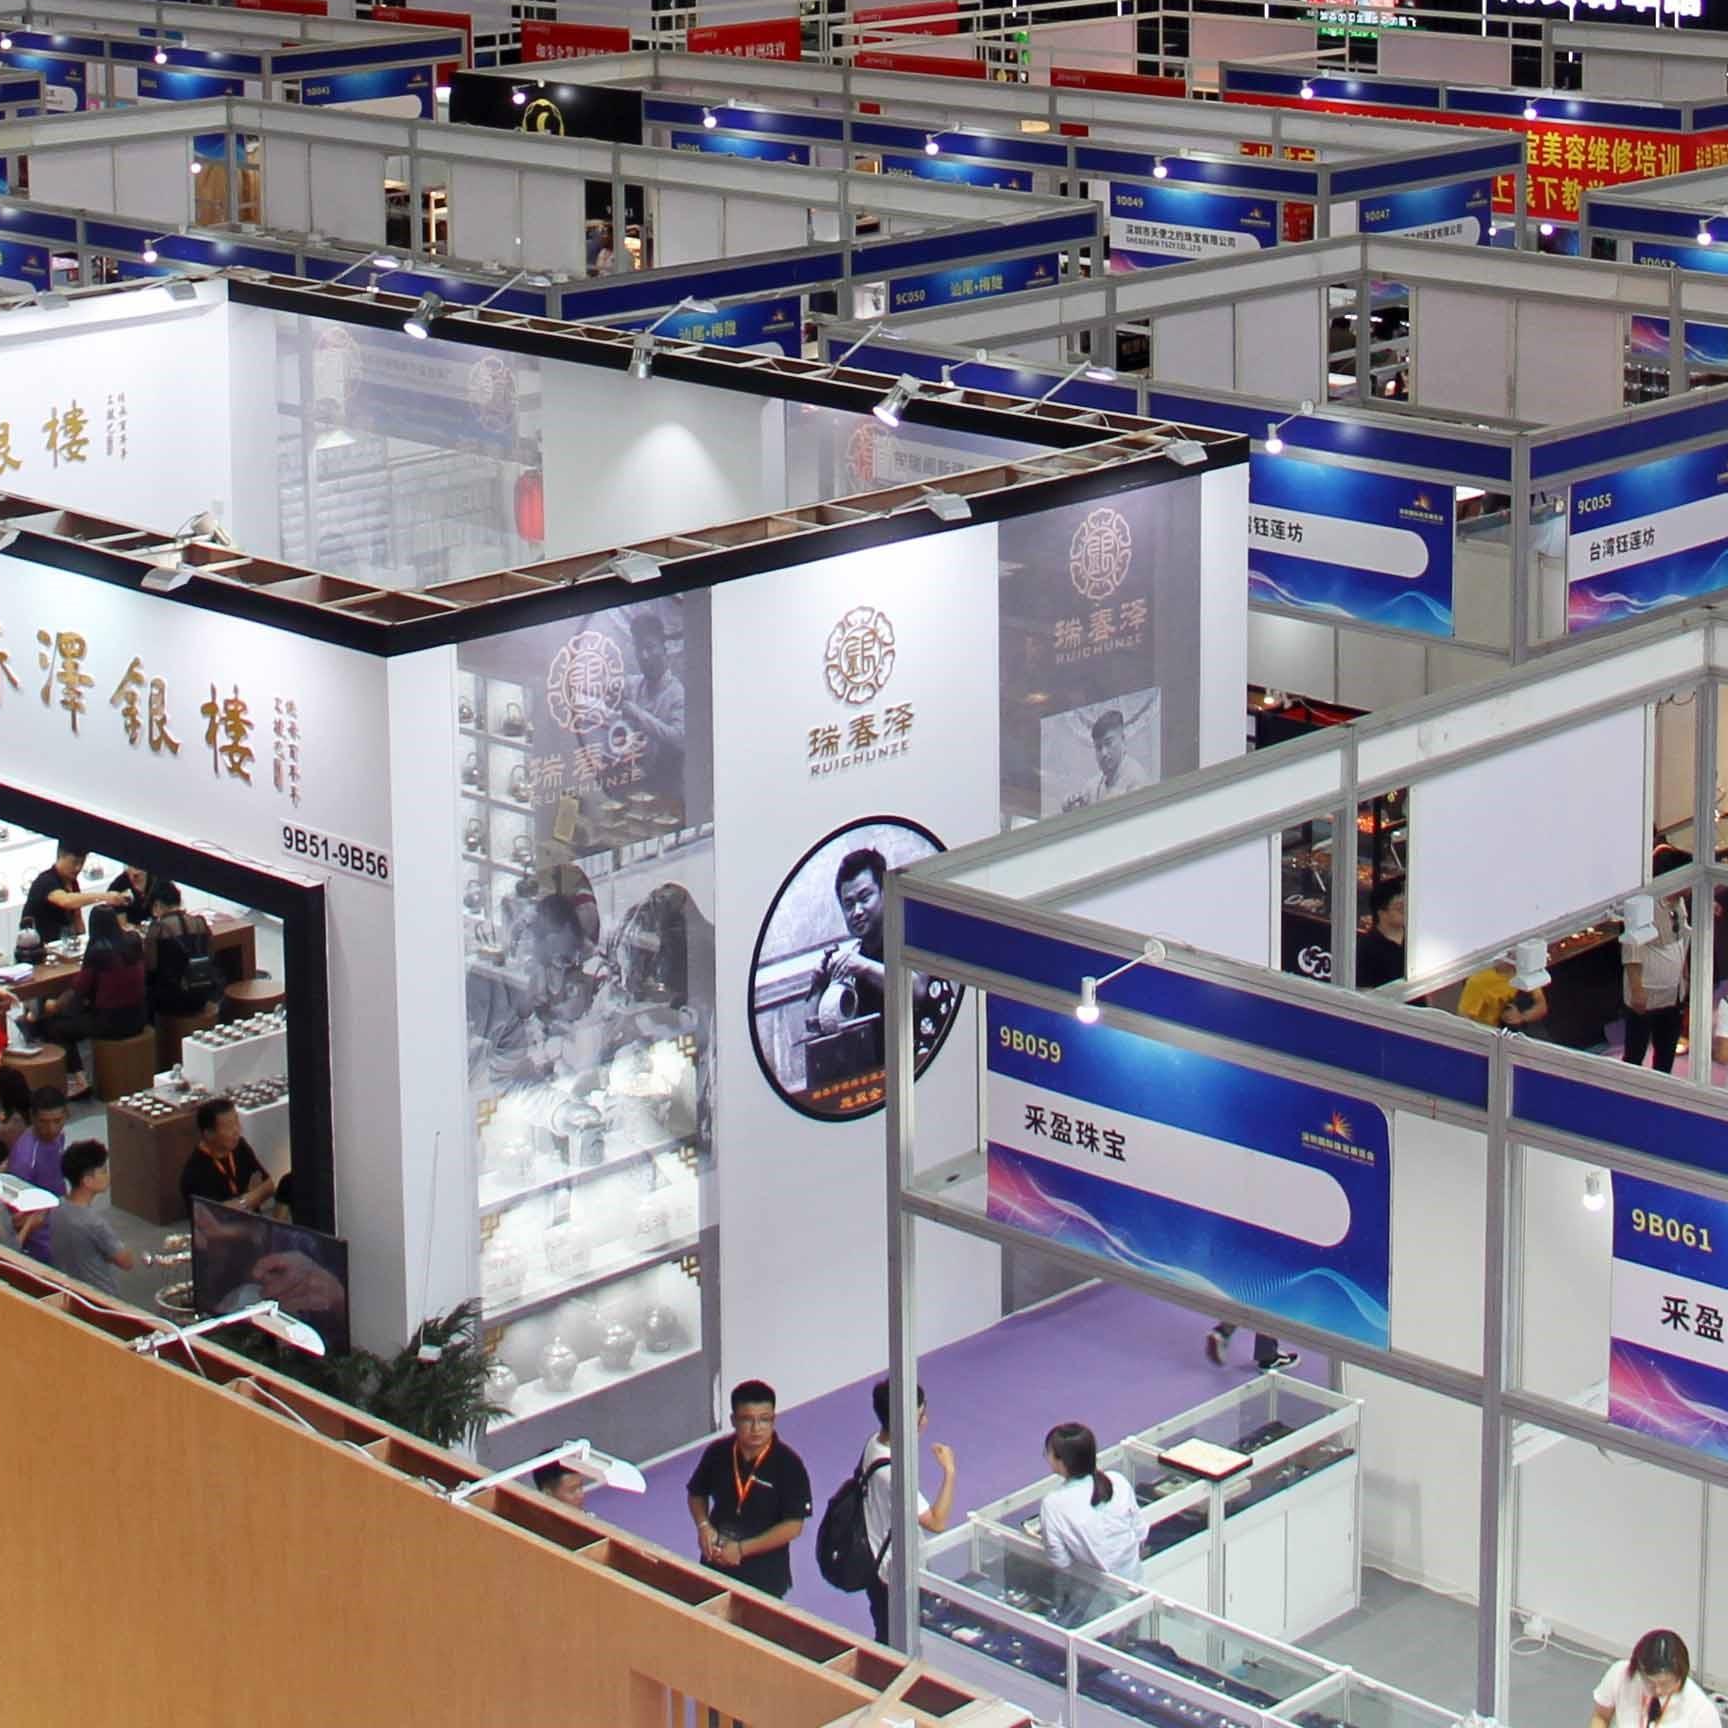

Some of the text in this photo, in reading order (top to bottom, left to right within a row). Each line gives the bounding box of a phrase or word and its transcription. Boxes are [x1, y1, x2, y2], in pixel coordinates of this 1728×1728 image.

[1577, 492, 1613, 515] 9C055
[1588, 526, 1656, 564] 台湾钰莲坊
[1052, 595, 1147, 649] 瑞春泽
[1055, 631, 1143, 665] RUICHUNZE
[808, 700, 916, 758] 瑞春泽
[809, 739, 911, 776] RUICHUNZE
[281, 823, 389, 881] 9B51-9B56
[999, 1025, 1062, 1064] 9B059
[1630, 1207, 1714, 1253] 9B061
